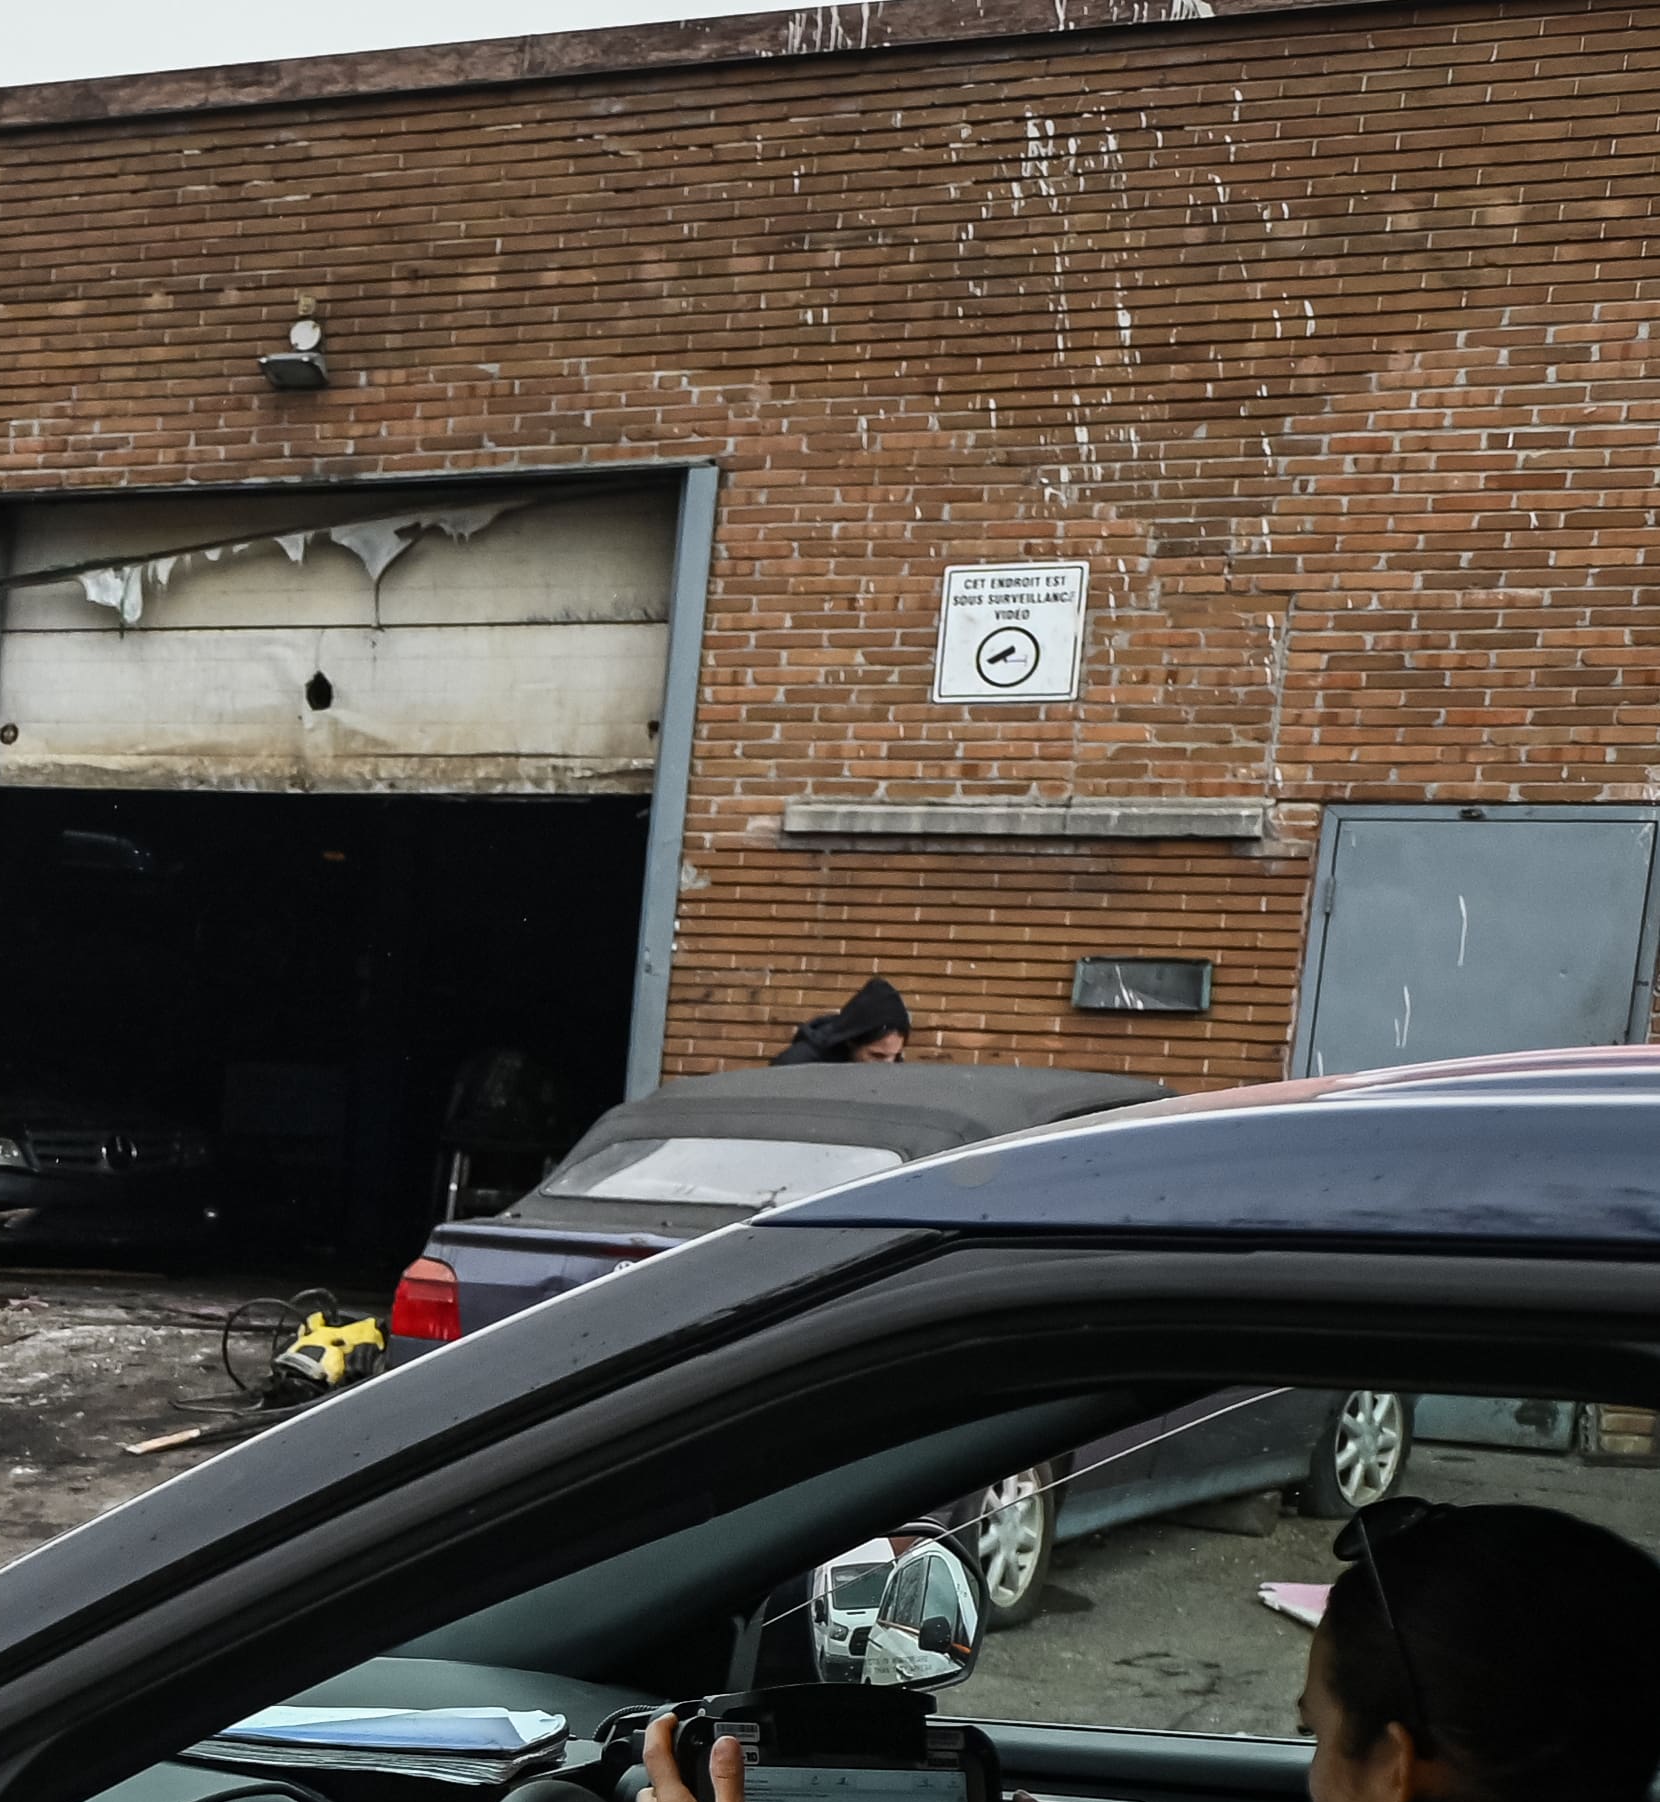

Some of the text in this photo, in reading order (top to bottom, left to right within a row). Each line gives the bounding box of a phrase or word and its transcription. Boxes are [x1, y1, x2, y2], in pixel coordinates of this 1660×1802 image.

[963, 575, 1066, 589] CET ENDROIT EST
[952, 595, 984, 606] SOUS
